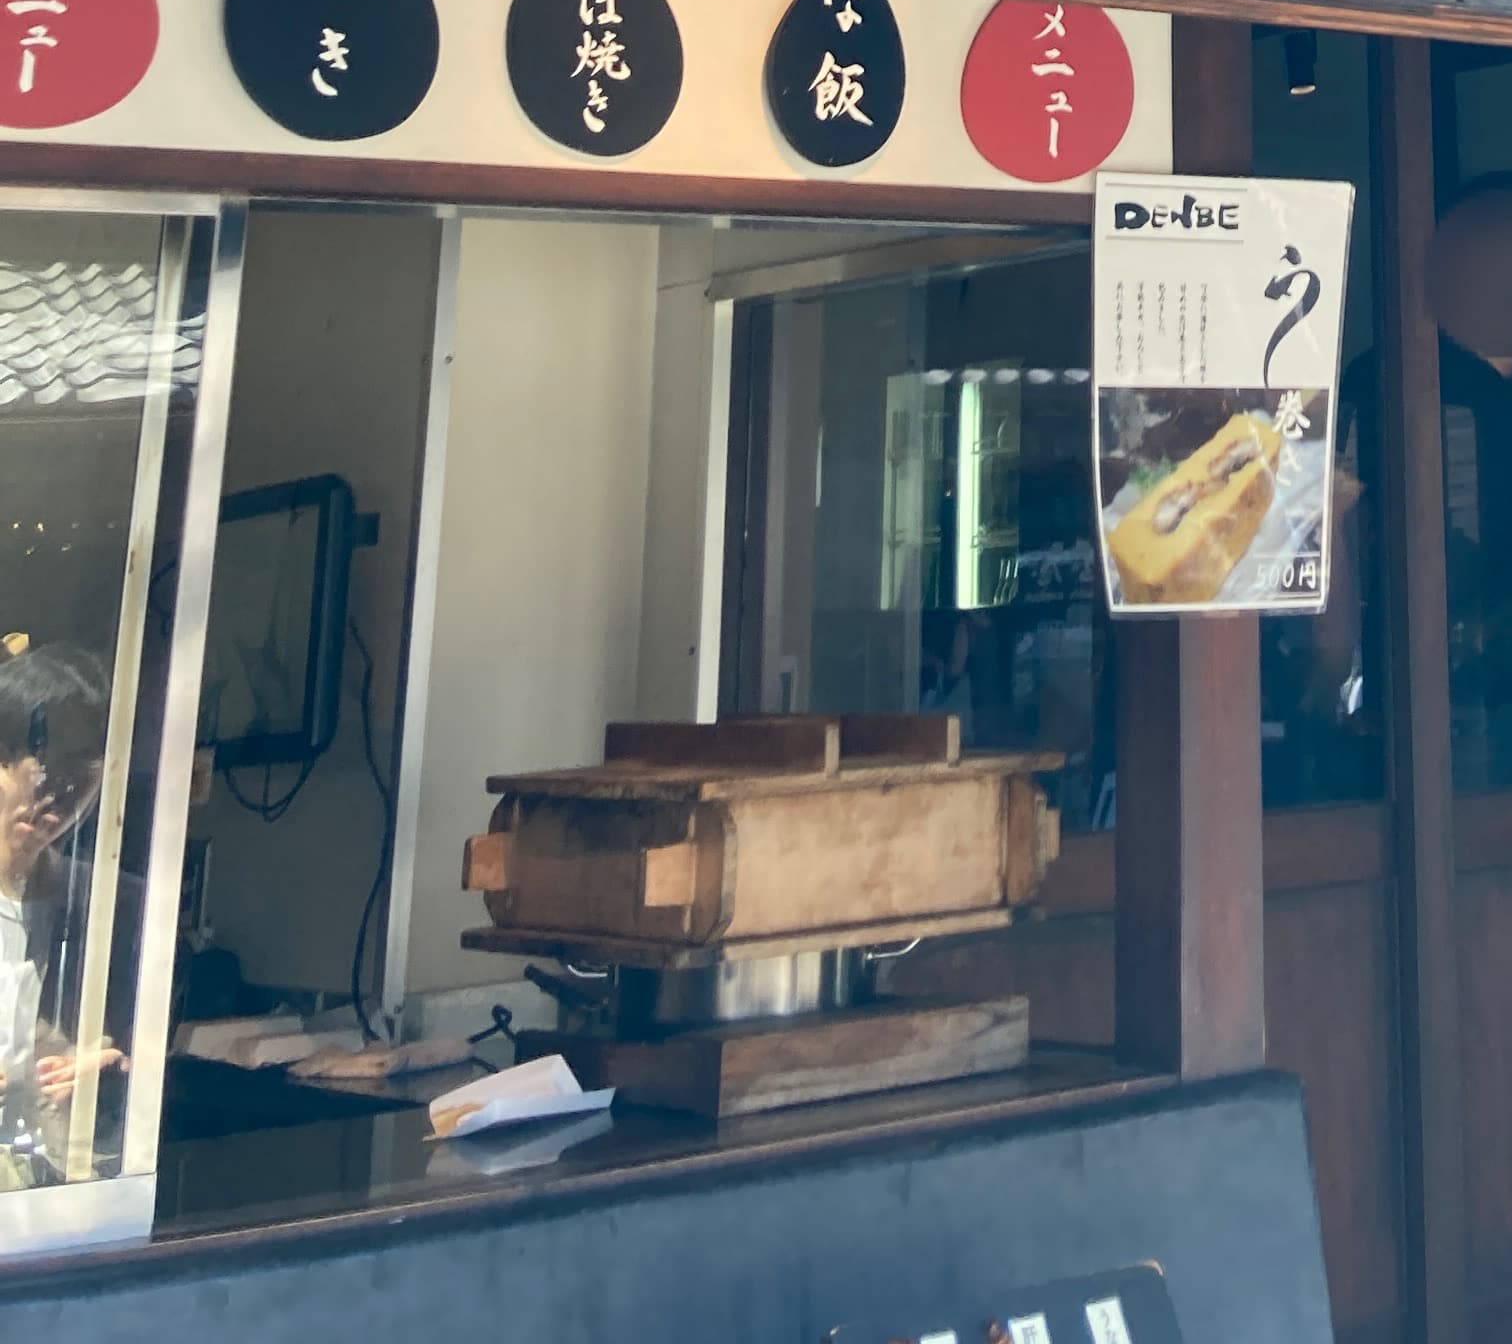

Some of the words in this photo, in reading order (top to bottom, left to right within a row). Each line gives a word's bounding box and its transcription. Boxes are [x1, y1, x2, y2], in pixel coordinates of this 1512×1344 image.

[1031, 3, 1075, 158] メニュー
[1114, 193, 1240, 232] DENBE
[1255, 559, 1318, 590] 500円
